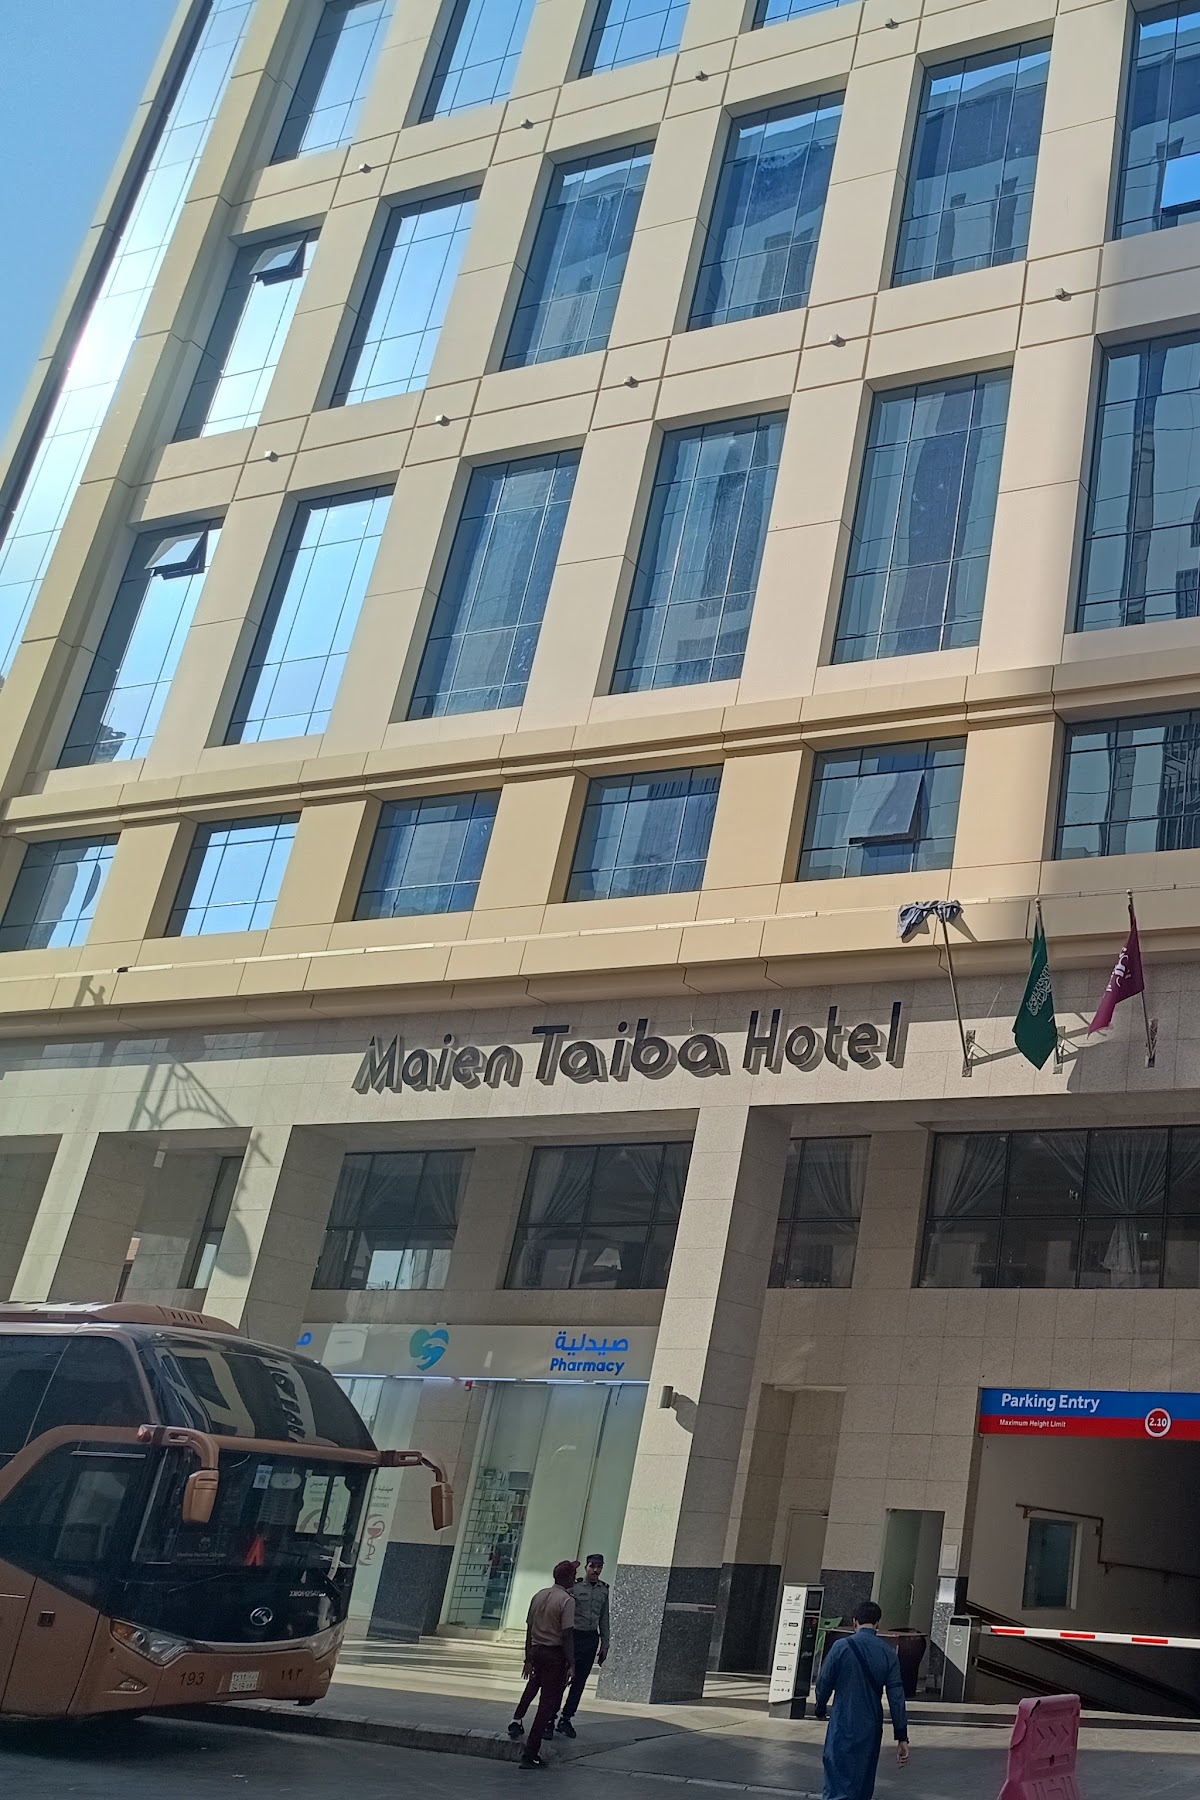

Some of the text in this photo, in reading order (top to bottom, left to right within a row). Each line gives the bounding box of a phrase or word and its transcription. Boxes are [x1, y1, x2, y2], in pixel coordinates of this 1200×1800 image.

[351, 1001, 908, 1094] Maien Taiba Hotel
[555, 1331, 628, 1356] صيدلية
[550, 1358, 625, 1376] Pharmacy
[1001, 1392, 1100, 1413] Parking Entry
[1000, 1419, 1028, 1427] Maximum
[1029, 1420, 1049, 1429] Height
[1149, 1417, 1168, 1427] 2.10
[179, 1672, 205, 1686] 193
